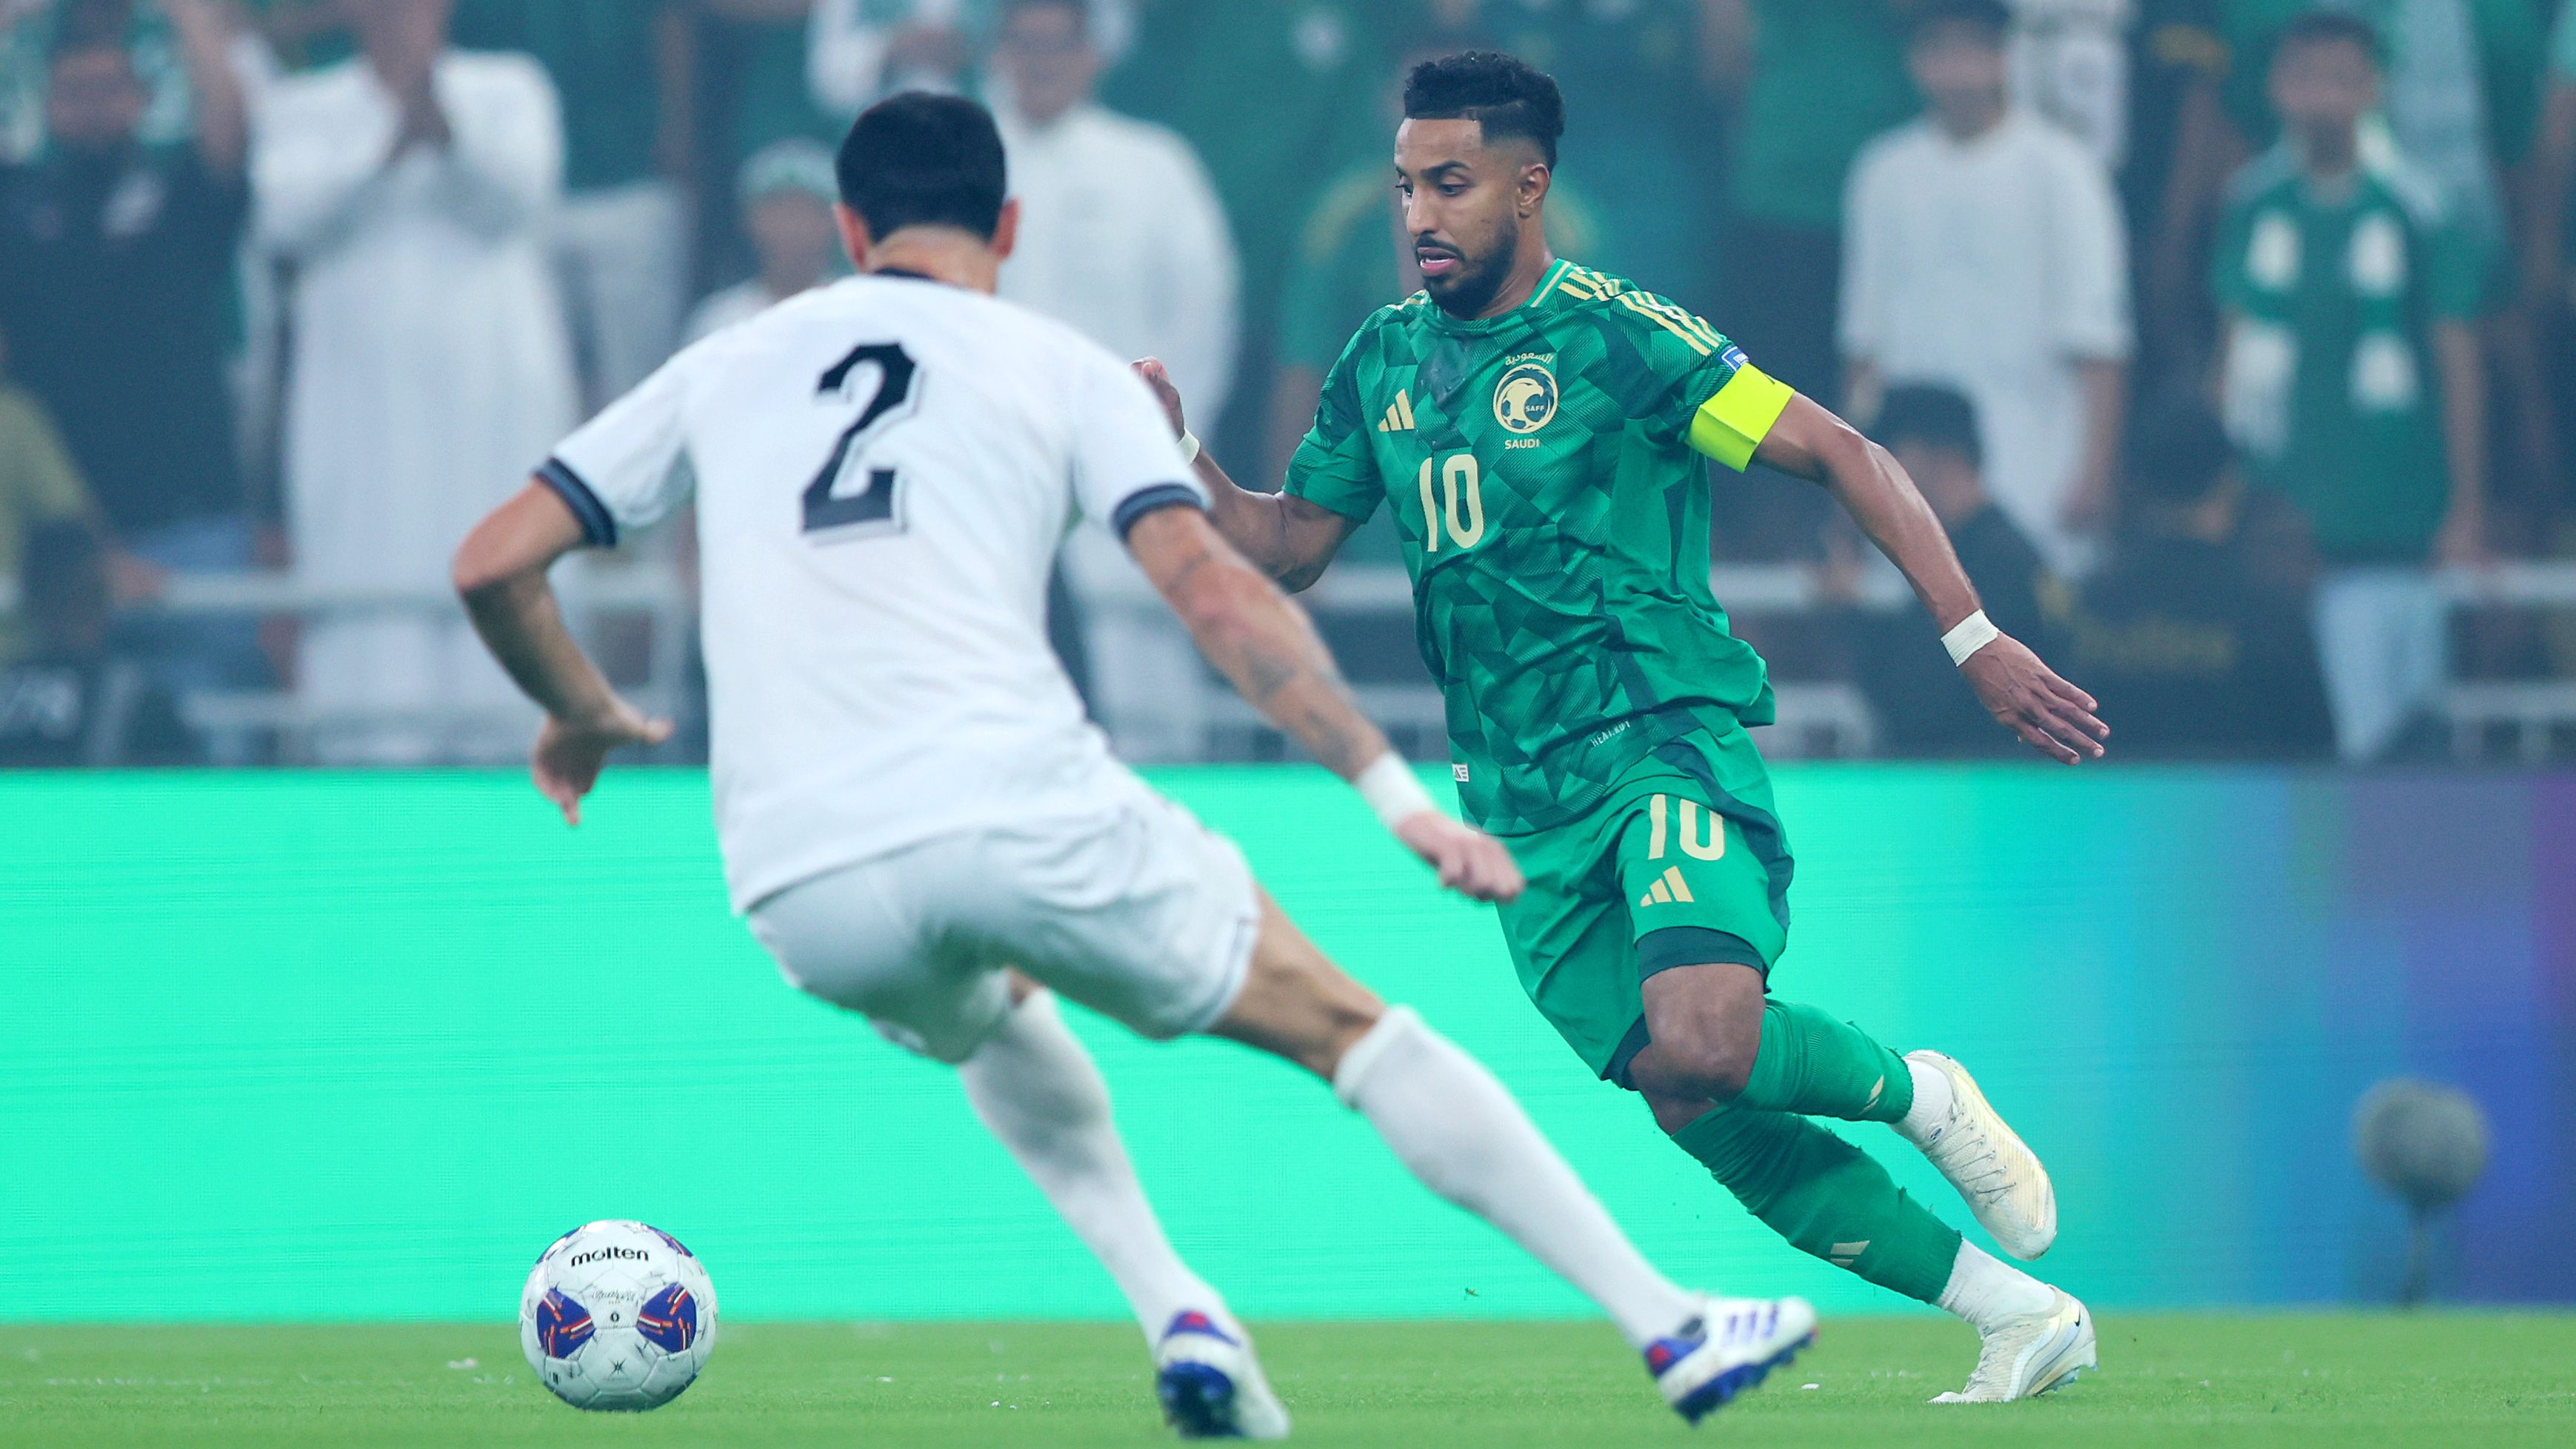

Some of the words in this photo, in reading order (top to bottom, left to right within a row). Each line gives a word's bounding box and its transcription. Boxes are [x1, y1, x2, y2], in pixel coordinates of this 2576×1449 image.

[1505, 352, 1554, 366] السعودية
[801, 340, 923, 541] 2
[1504, 438, 1541, 450] SAUDI
[1418, 453, 1484, 552] 10
[1647, 793, 1726, 862] 10
[570, 1246, 650, 1268] molten
